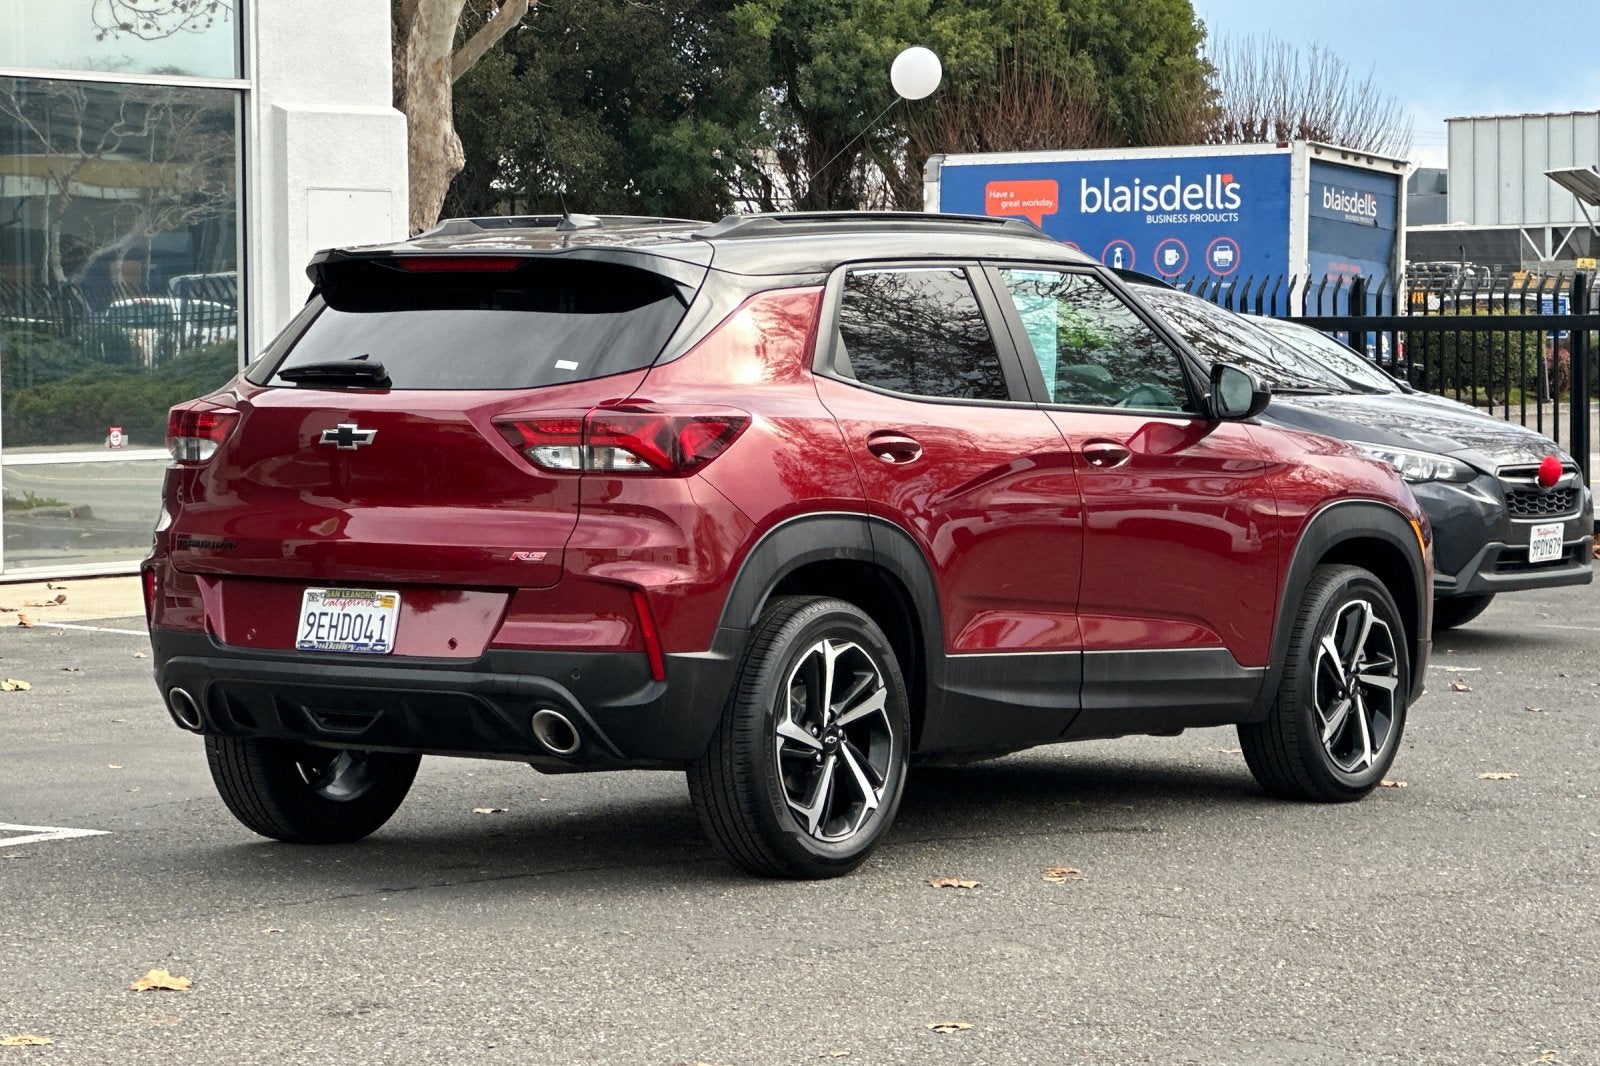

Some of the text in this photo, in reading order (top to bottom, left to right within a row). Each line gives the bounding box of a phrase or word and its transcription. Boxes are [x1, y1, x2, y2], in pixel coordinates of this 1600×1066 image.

[989, 190, 1008, 198] Have
[1001, 198, 1055, 209] great workday.
[1146, 212, 1239, 224] BUSINESS PRODUCTS
[1532, 536, 1561, 557] 9PDY879
[509, 551, 547, 561] RS
[326, 590, 375, 600] SAN LEANDRO
[321, 596, 375, 611] California
[303, 611, 386, 643] 9EHD041
